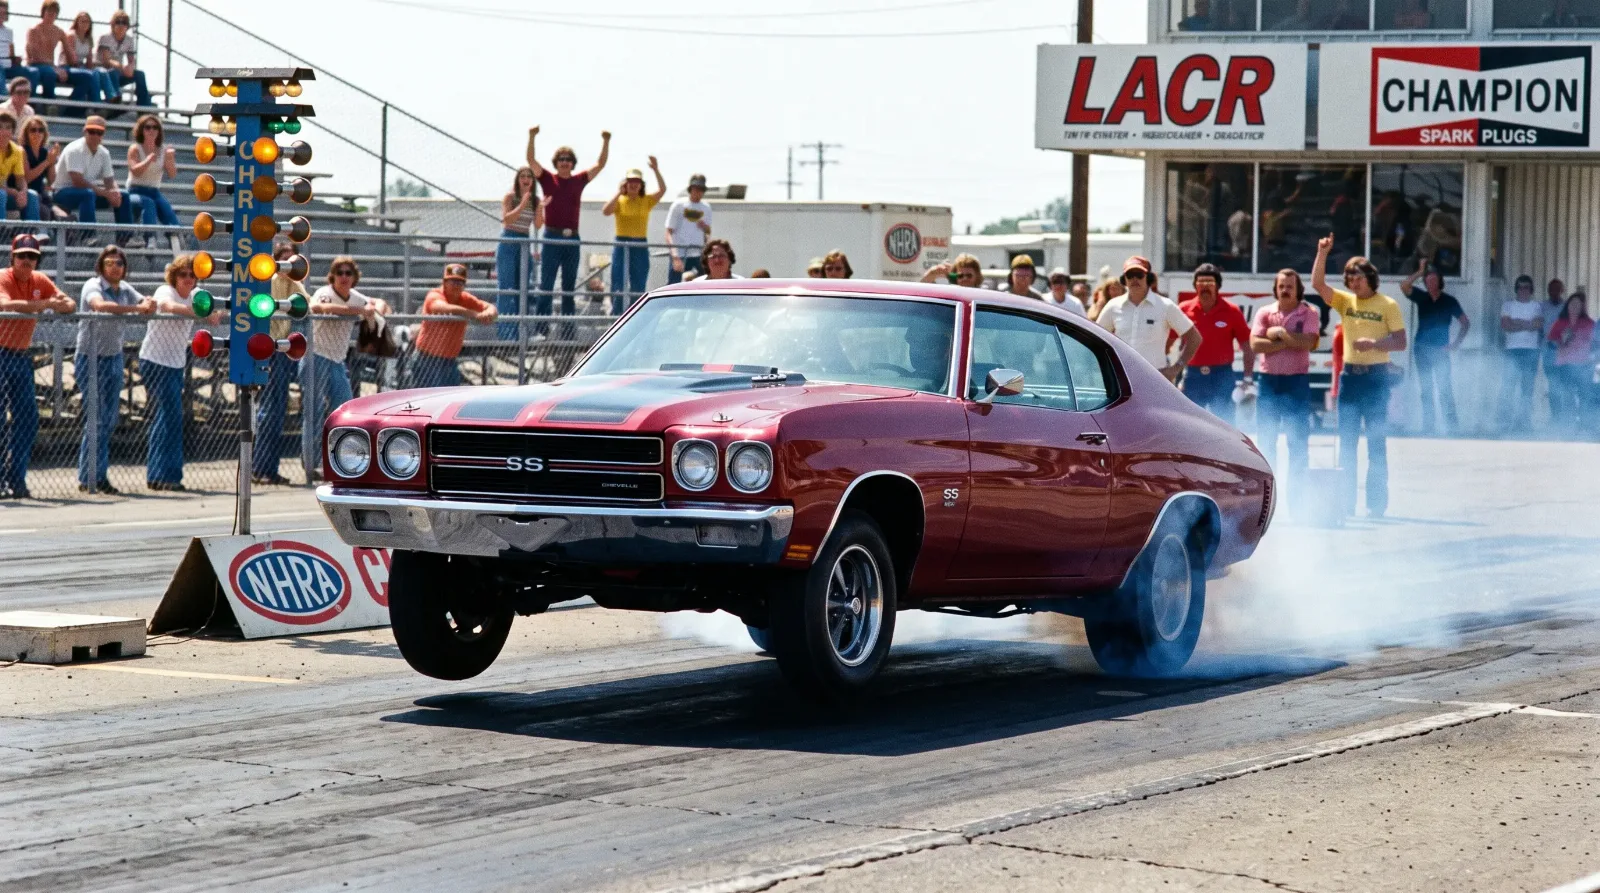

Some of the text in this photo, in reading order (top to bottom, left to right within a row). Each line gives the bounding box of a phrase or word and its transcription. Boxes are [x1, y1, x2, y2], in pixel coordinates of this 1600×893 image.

[1063, 53, 1275, 127] LACR
[1382, 78, 1578, 113] CHAMPION
[1419, 129, 1538, 144] SPARK PLUGS
[889, 228, 918, 258] NHRA
[506, 456, 544, 472] SS
[943, 488, 959, 500] SS
[245, 555, 338, 609] NHRA
